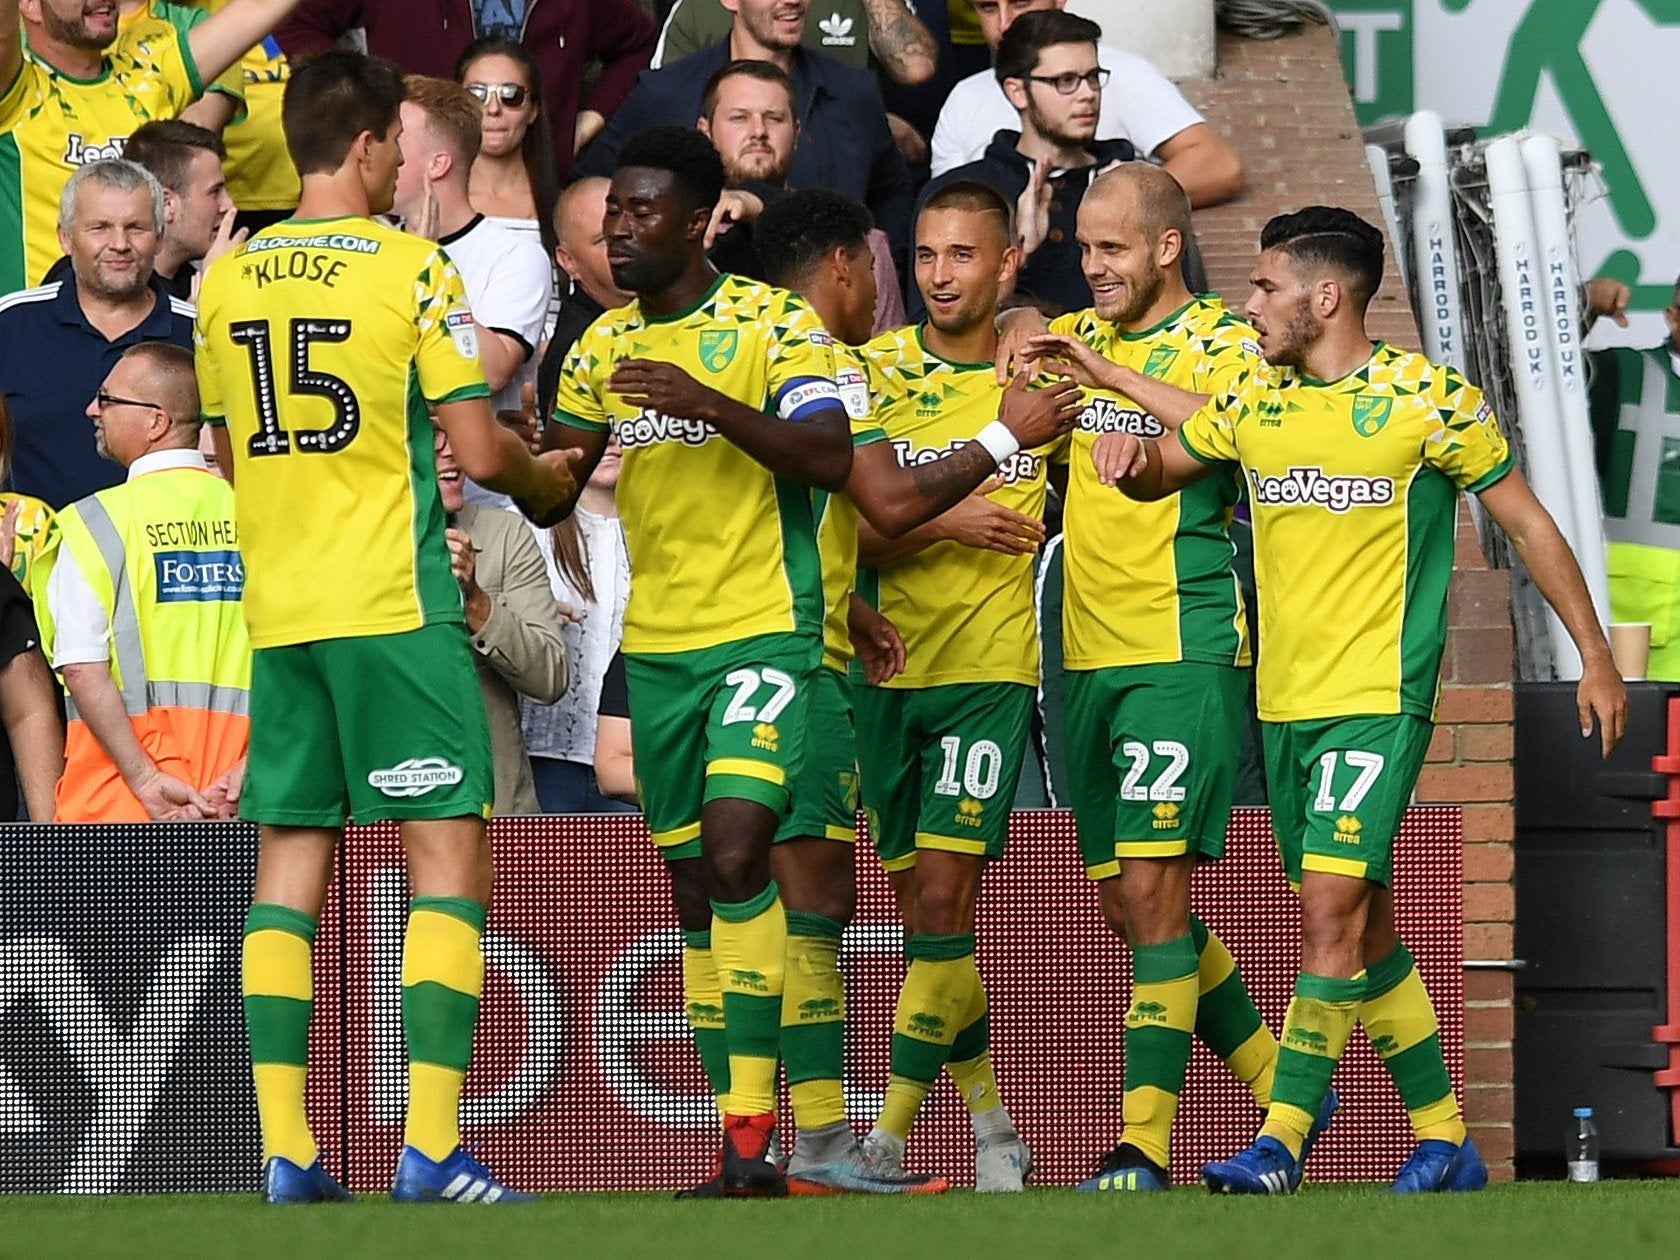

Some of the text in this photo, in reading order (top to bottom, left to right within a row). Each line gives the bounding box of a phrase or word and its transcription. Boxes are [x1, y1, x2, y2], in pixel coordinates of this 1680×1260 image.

[254, 250, 348, 290] KLOSE
[1429, 238, 1452, 353] HARROD UK
[1515, 259, 1542, 374] HARROD UK
[1550, 261, 1574, 377] HARROD UK
[229, 318, 360, 458] 15
[1250, 468, 1394, 512] LeoVegas
[145, 519, 208, 547] SECTION
[721, 667, 797, 727] 27
[373, 771, 456, 785] SHRED STATION
[934, 735, 1003, 800] 10
[1120, 740, 1190, 801] 22
[1313, 750, 1385, 812] 17
